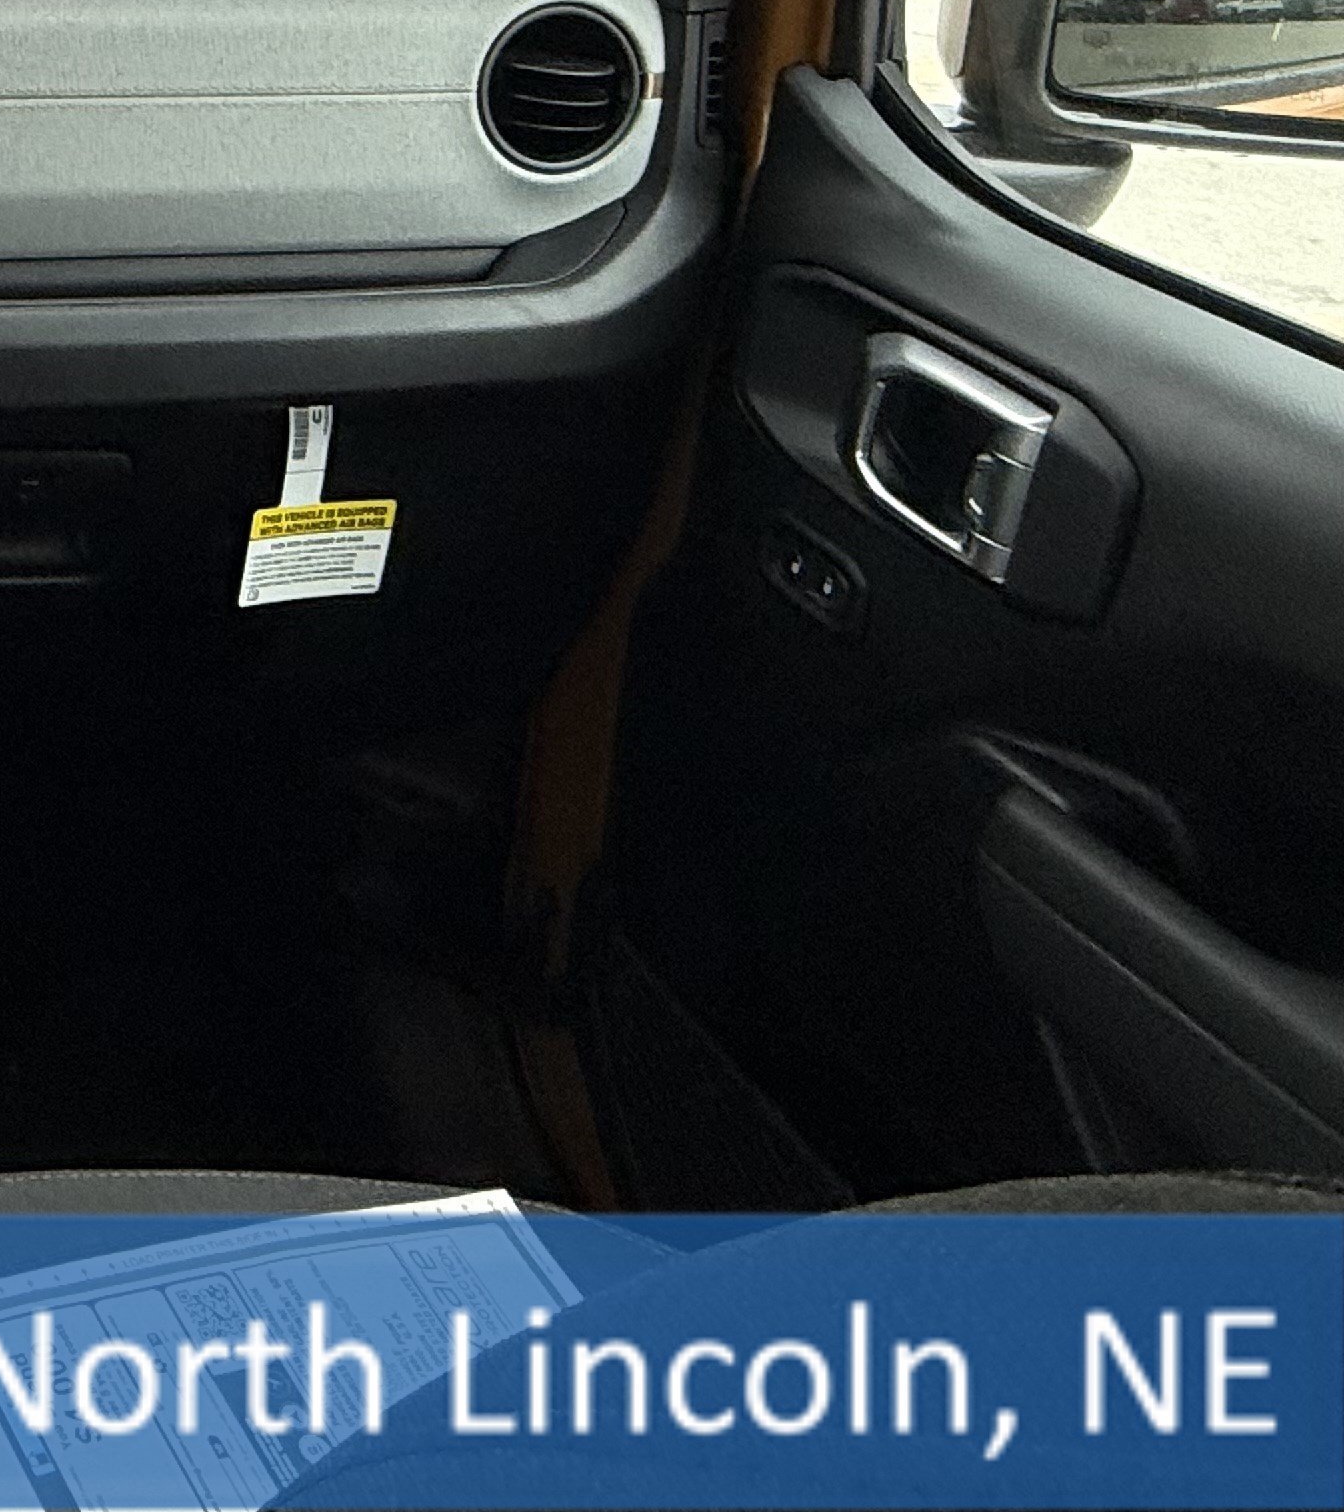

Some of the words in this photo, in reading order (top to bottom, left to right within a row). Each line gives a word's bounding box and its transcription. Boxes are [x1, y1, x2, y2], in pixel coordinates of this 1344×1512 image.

[262, 513, 283, 524] THIS
[285, 509, 324, 522] VEHICLE
[337, 506, 388, 518] EQUIPPED
[260, 526, 283, 536] WITH
[285, 520, 338, 533] ADVANCED
[338, 518, 356, 528] AIR
[357, 518, 386, 528] BAGS
[121, 1255, 156, 1268] LOAD
